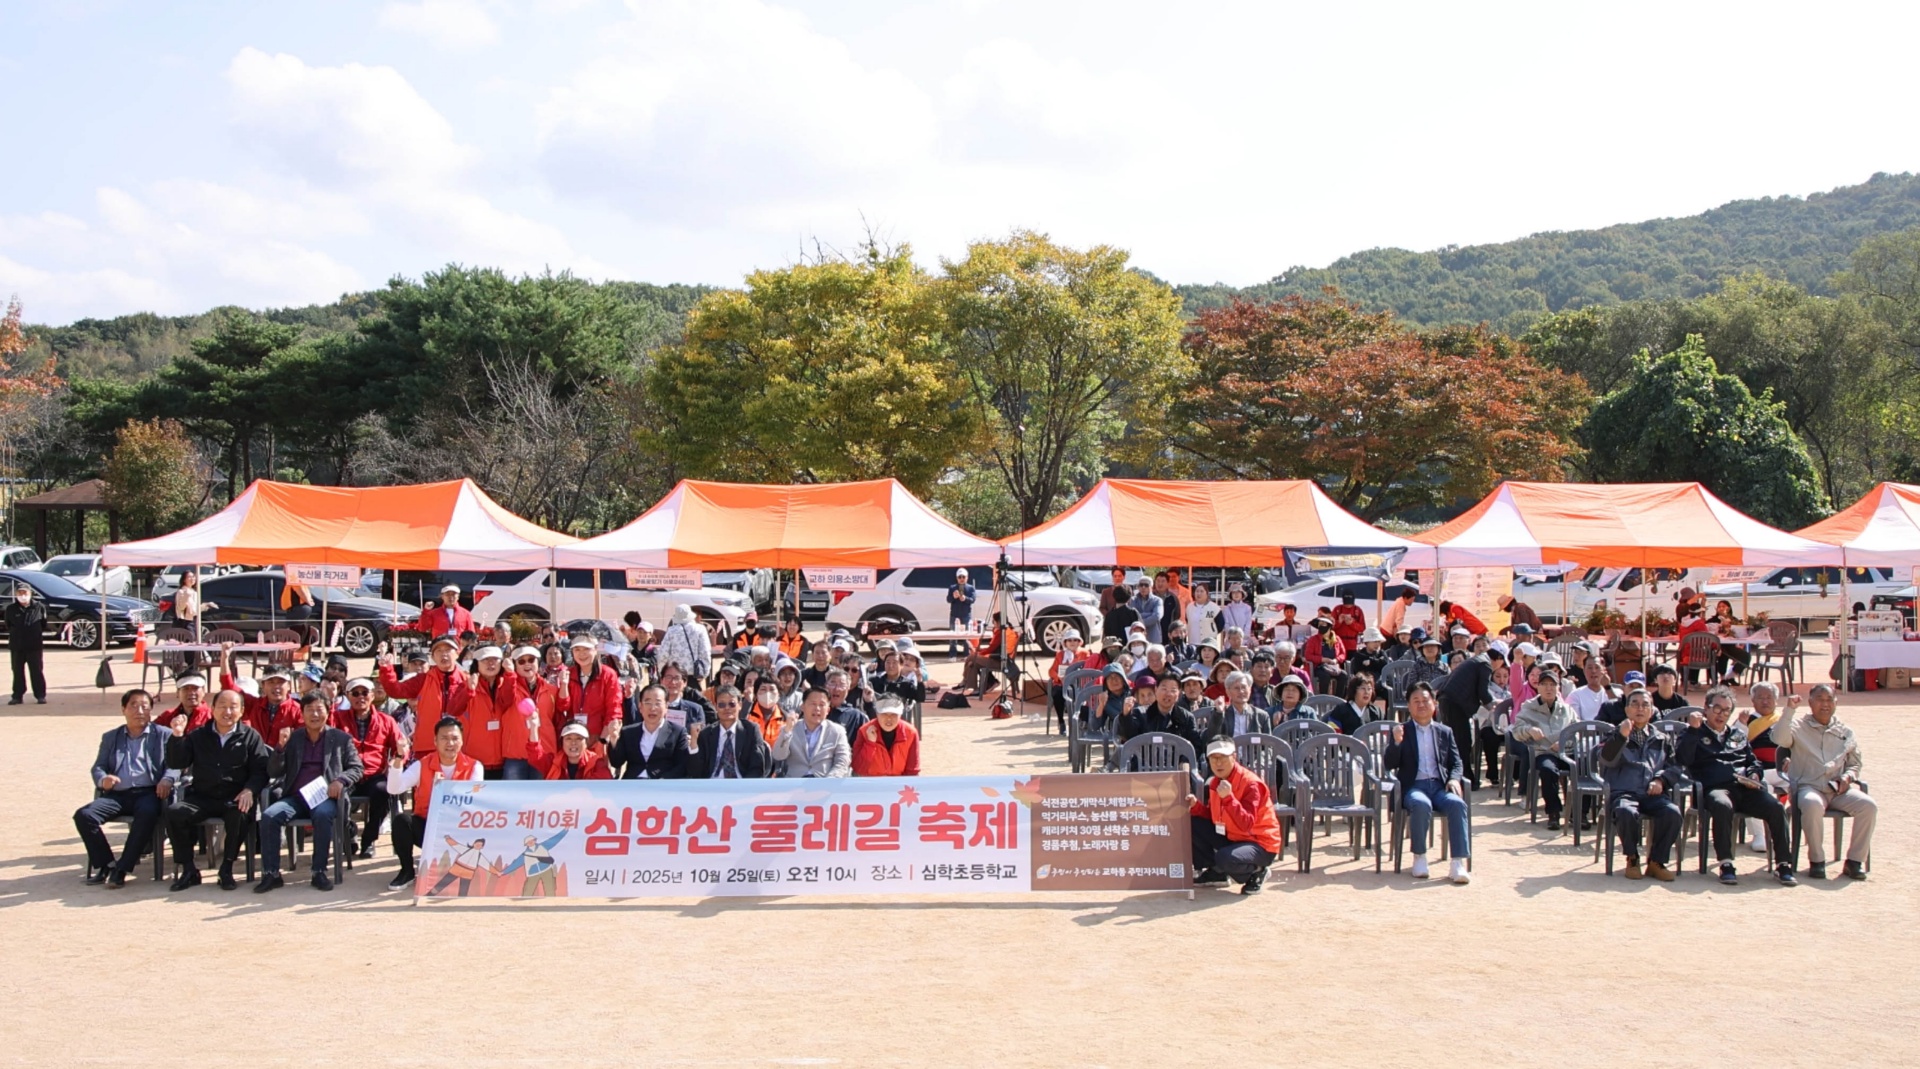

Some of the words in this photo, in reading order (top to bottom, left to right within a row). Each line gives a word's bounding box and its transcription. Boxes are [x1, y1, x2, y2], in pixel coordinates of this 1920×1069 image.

[298, 570, 321, 580] 농산물
[323, 571, 348, 580] 직거래
[809, 575, 825, 584] 교하
[827, 574, 868, 584] 의용소방대
[442, 795, 473, 806] PAJU
[458, 810, 508, 829] 2025
[515, 809, 580, 830] 제10회
[1041, 811, 1089, 822] 먹거리부스,
[1090, 811, 1118, 822] 농산물
[1120, 811, 1150, 821] 직거래,
[584, 805, 737, 856] 심학산
[750, 802, 901, 854] 둘레길
[918, 801, 1018, 851] 축제
[1080, 826, 1101, 836] 30명
[1103, 825, 1130, 836] 선착순
[1132, 825, 1171, 837] 무료체험,
[1041, 840, 1080, 851] 경품추첨,
[1082, 840, 1119, 850] 노래자랑
[1120, 840, 1130, 850] 등
[584, 868, 615, 885] 일시
[632, 869, 682, 884] 2025년
[690, 868, 721, 884] 10월
[726, 868, 780, 883] 25일(토)
[786, 866, 819, 882] 오전
[826, 867, 857, 881] 10시
[870, 864, 903, 881] 장소
[921, 863, 1018, 881] 심학초등학교
[1102, 868, 1126, 877] 교하동
[1127, 867, 1167, 877] 주민자치회
